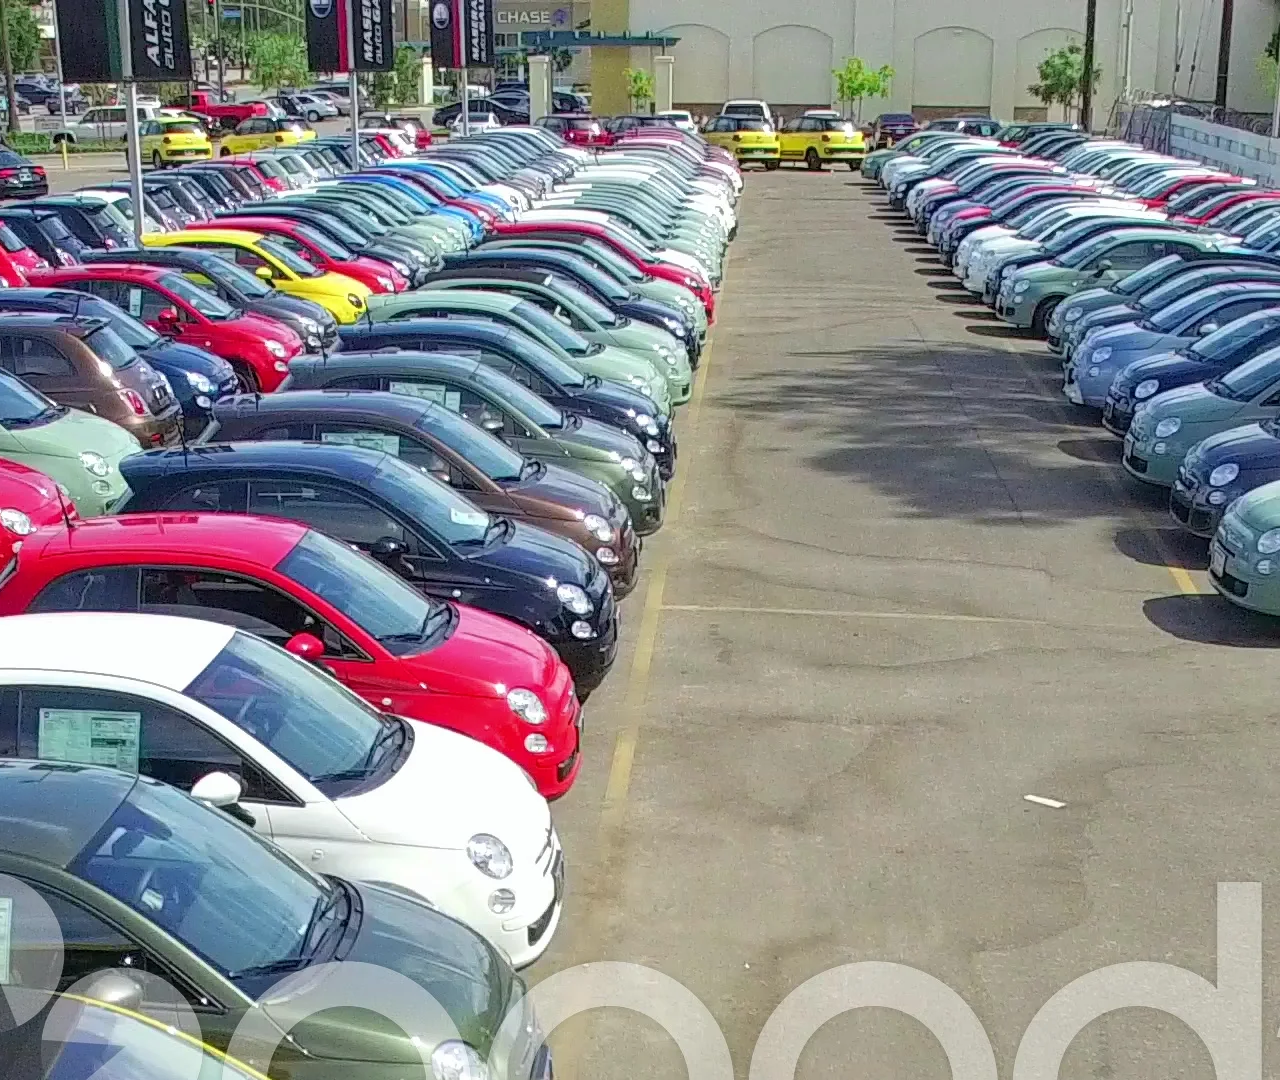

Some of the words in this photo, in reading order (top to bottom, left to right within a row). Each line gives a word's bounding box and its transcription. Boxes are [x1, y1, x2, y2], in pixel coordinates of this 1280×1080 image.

[143, 0, 160, 68] ALFA
[161, 10, 174, 70] auto
[497, 11, 550, 24] CHASE
[374, 24, 383, 65] auto
